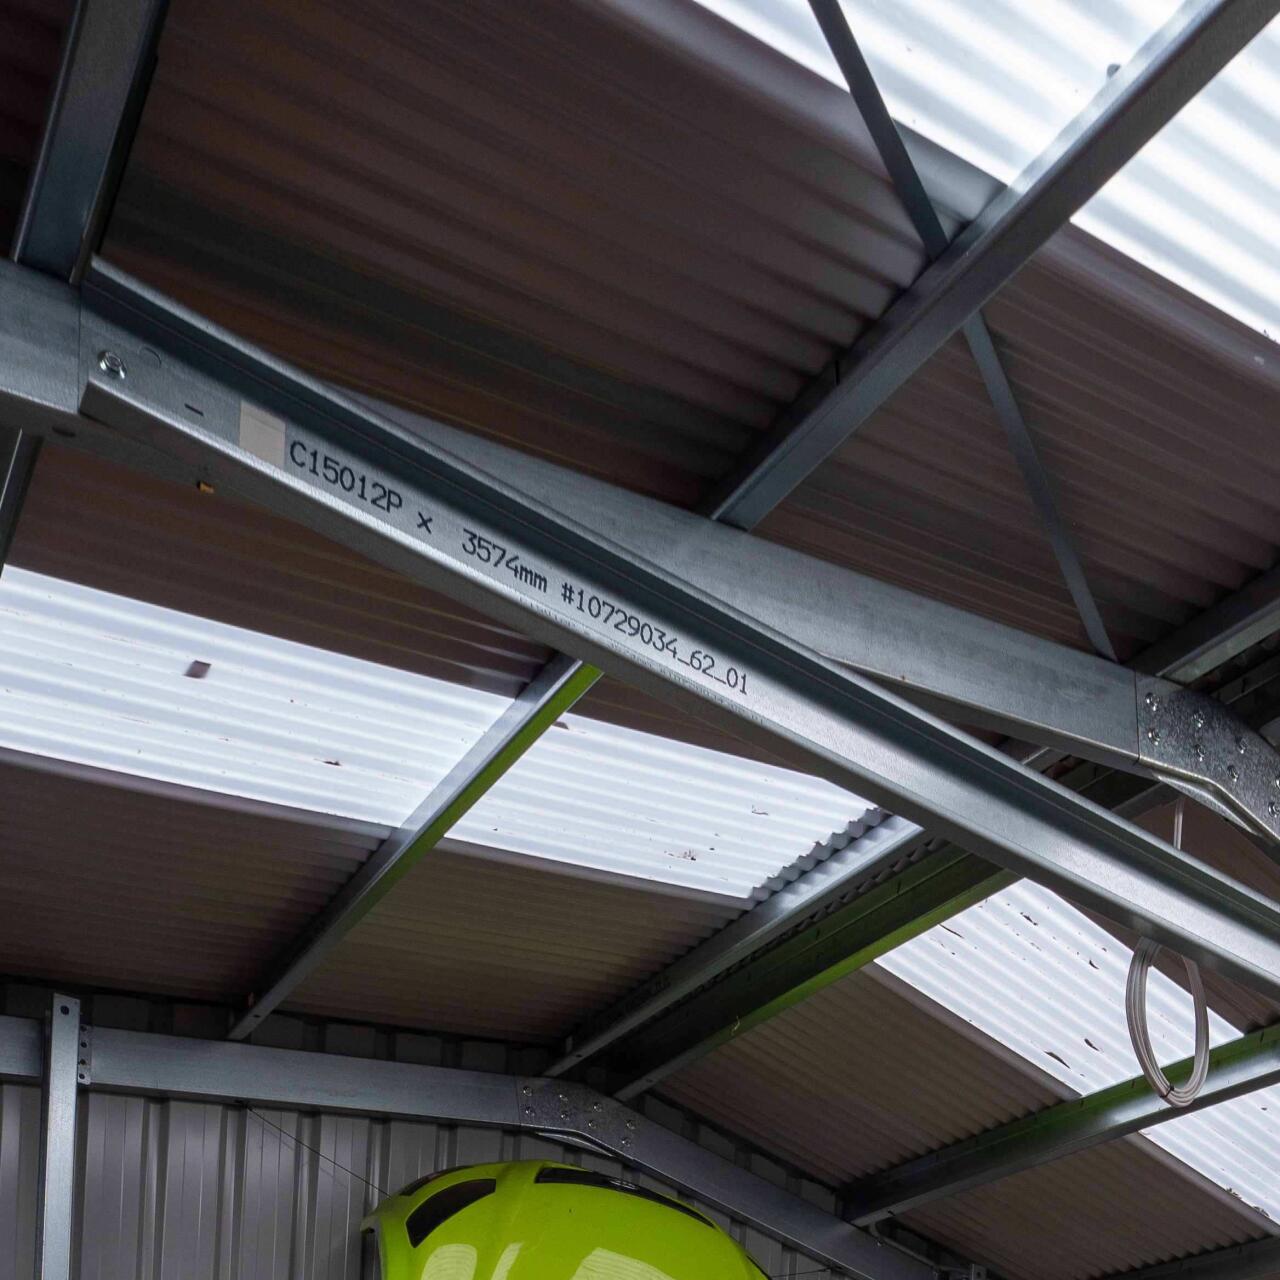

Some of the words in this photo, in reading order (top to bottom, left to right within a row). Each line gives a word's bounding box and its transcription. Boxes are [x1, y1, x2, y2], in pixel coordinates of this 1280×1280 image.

[289, 440, 403, 514] C15012P
[416, 511, 433, 535] x
[461, 527, 549, 595] 3574mm
[560, 581, 750, 697] #10729034_62_01
